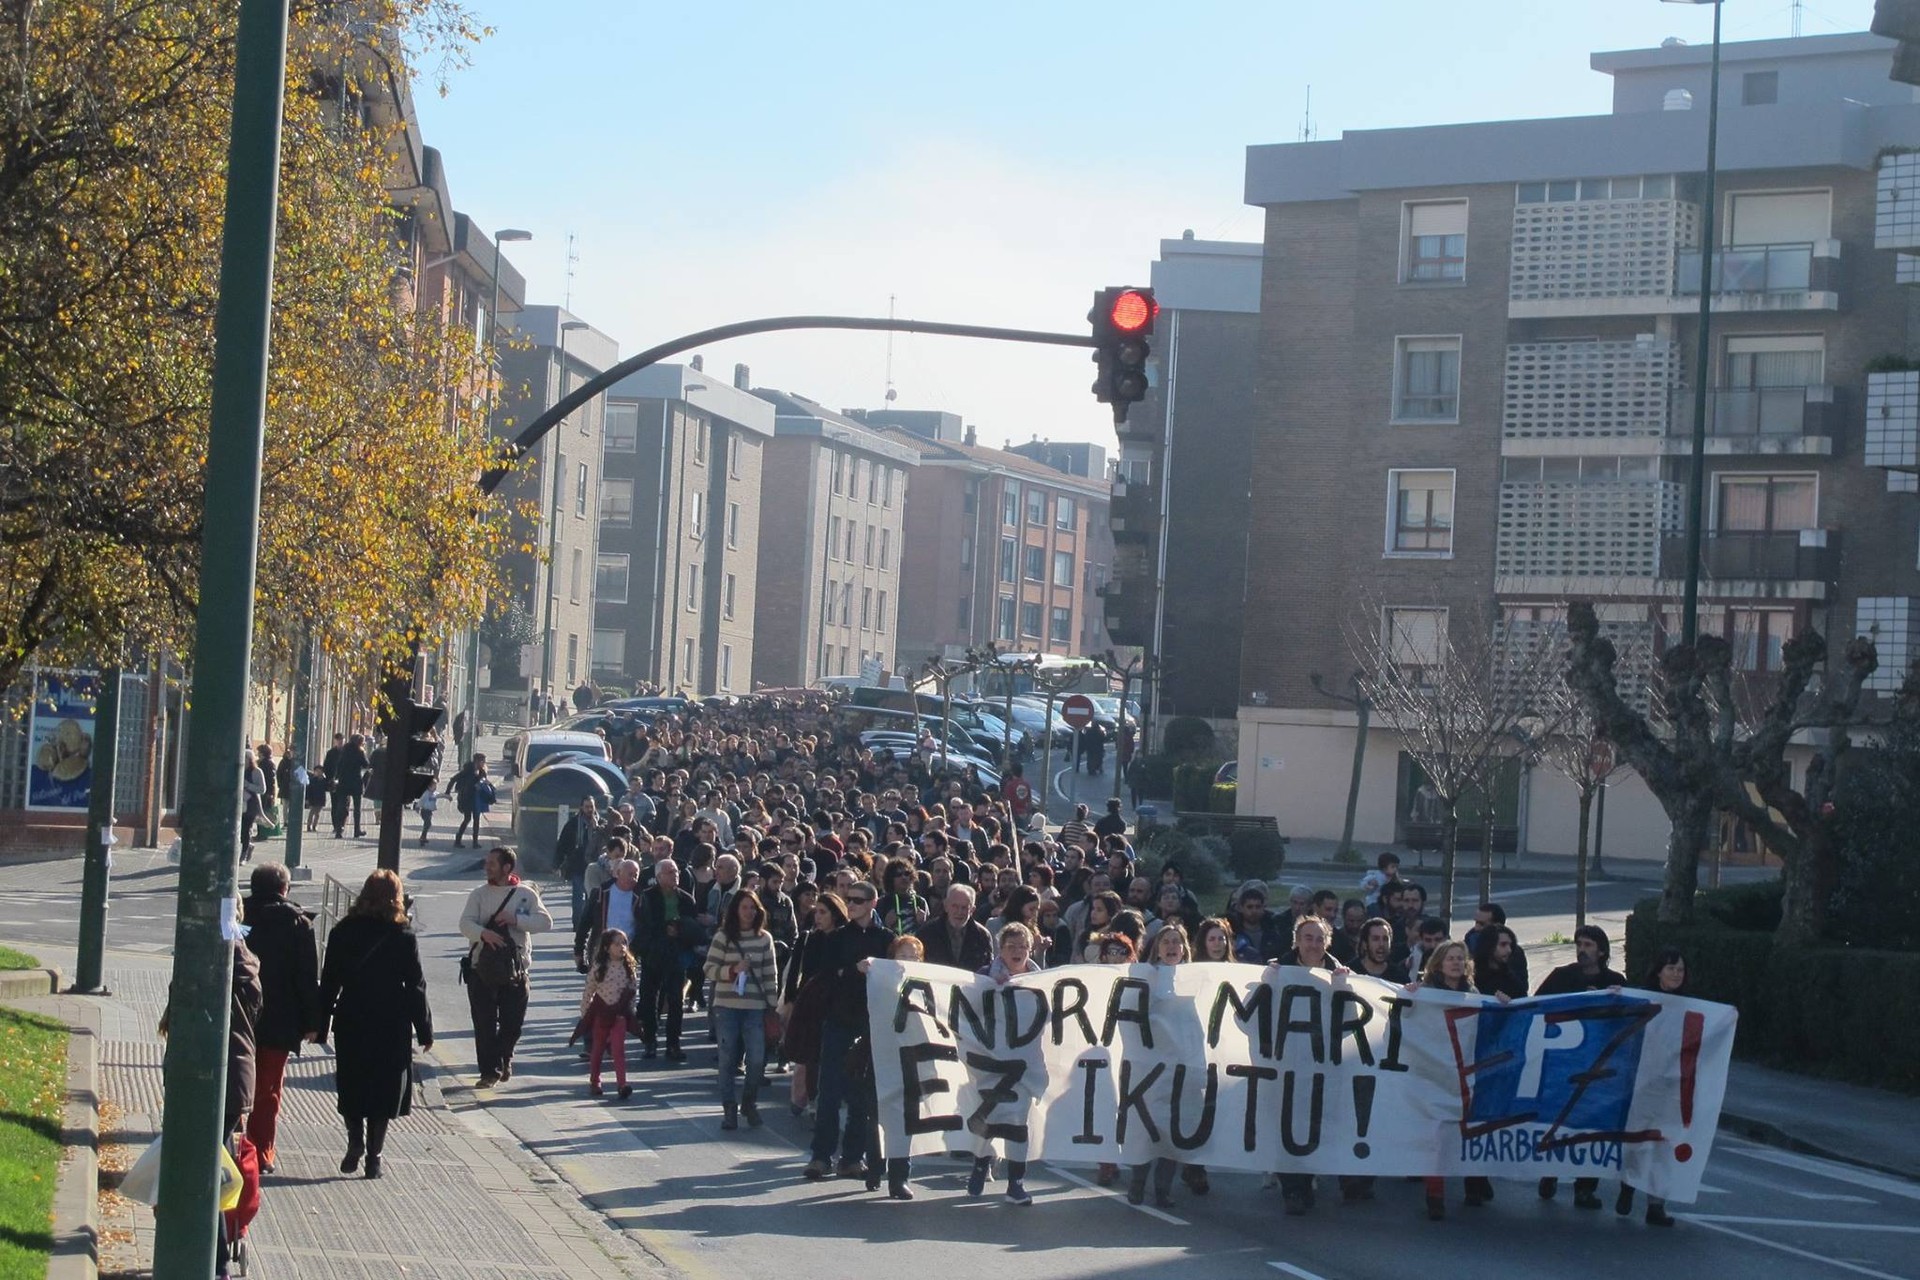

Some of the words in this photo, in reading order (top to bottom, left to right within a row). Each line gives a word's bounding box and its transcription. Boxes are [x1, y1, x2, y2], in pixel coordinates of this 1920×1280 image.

[894, 977, 1154, 1050] ANDRA
[1207, 981, 1413, 1072] MARI
[1516, 1014, 1585, 1099] P
[899, 1042, 1029, 1143] EZ
[1460, 1128, 1623, 1171] IBARBENGOA
